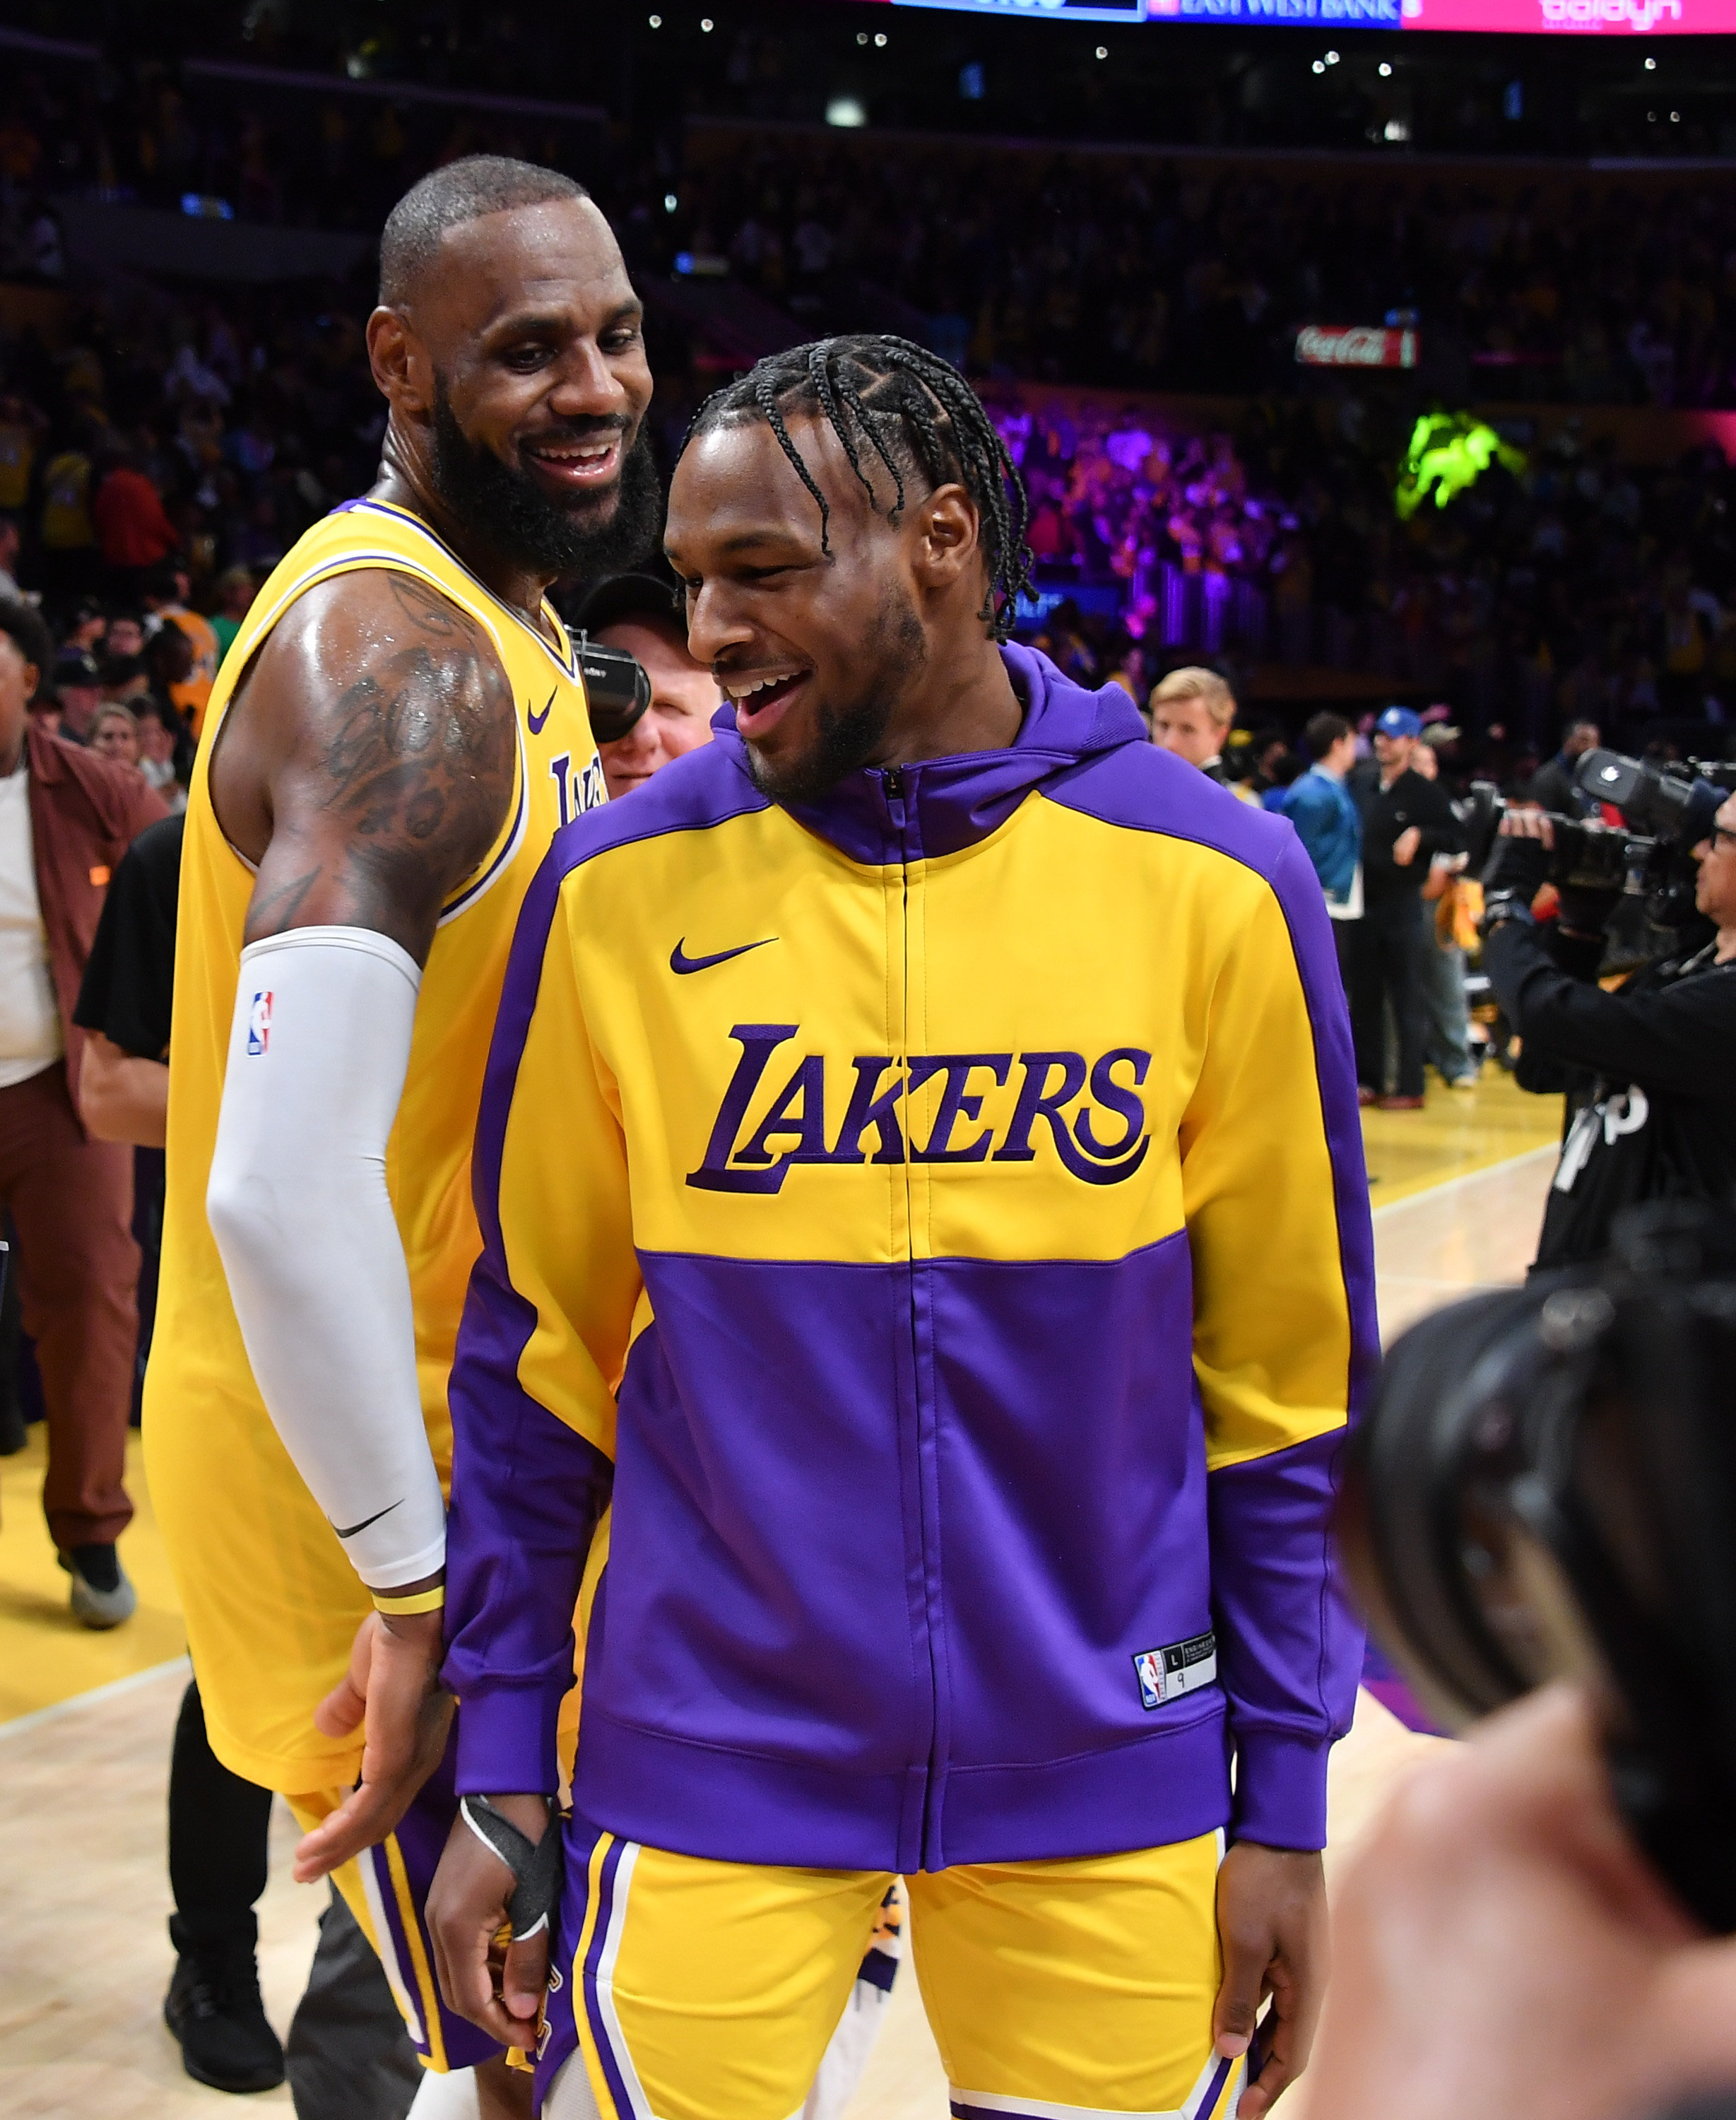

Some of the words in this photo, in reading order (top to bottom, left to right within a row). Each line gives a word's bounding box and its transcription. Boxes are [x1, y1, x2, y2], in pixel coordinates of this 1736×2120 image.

[685, 1023, 1152, 1194] LAKERS
[1171, 1654, 1179, 1666] L
[1177, 1673, 1185, 1688] 9
